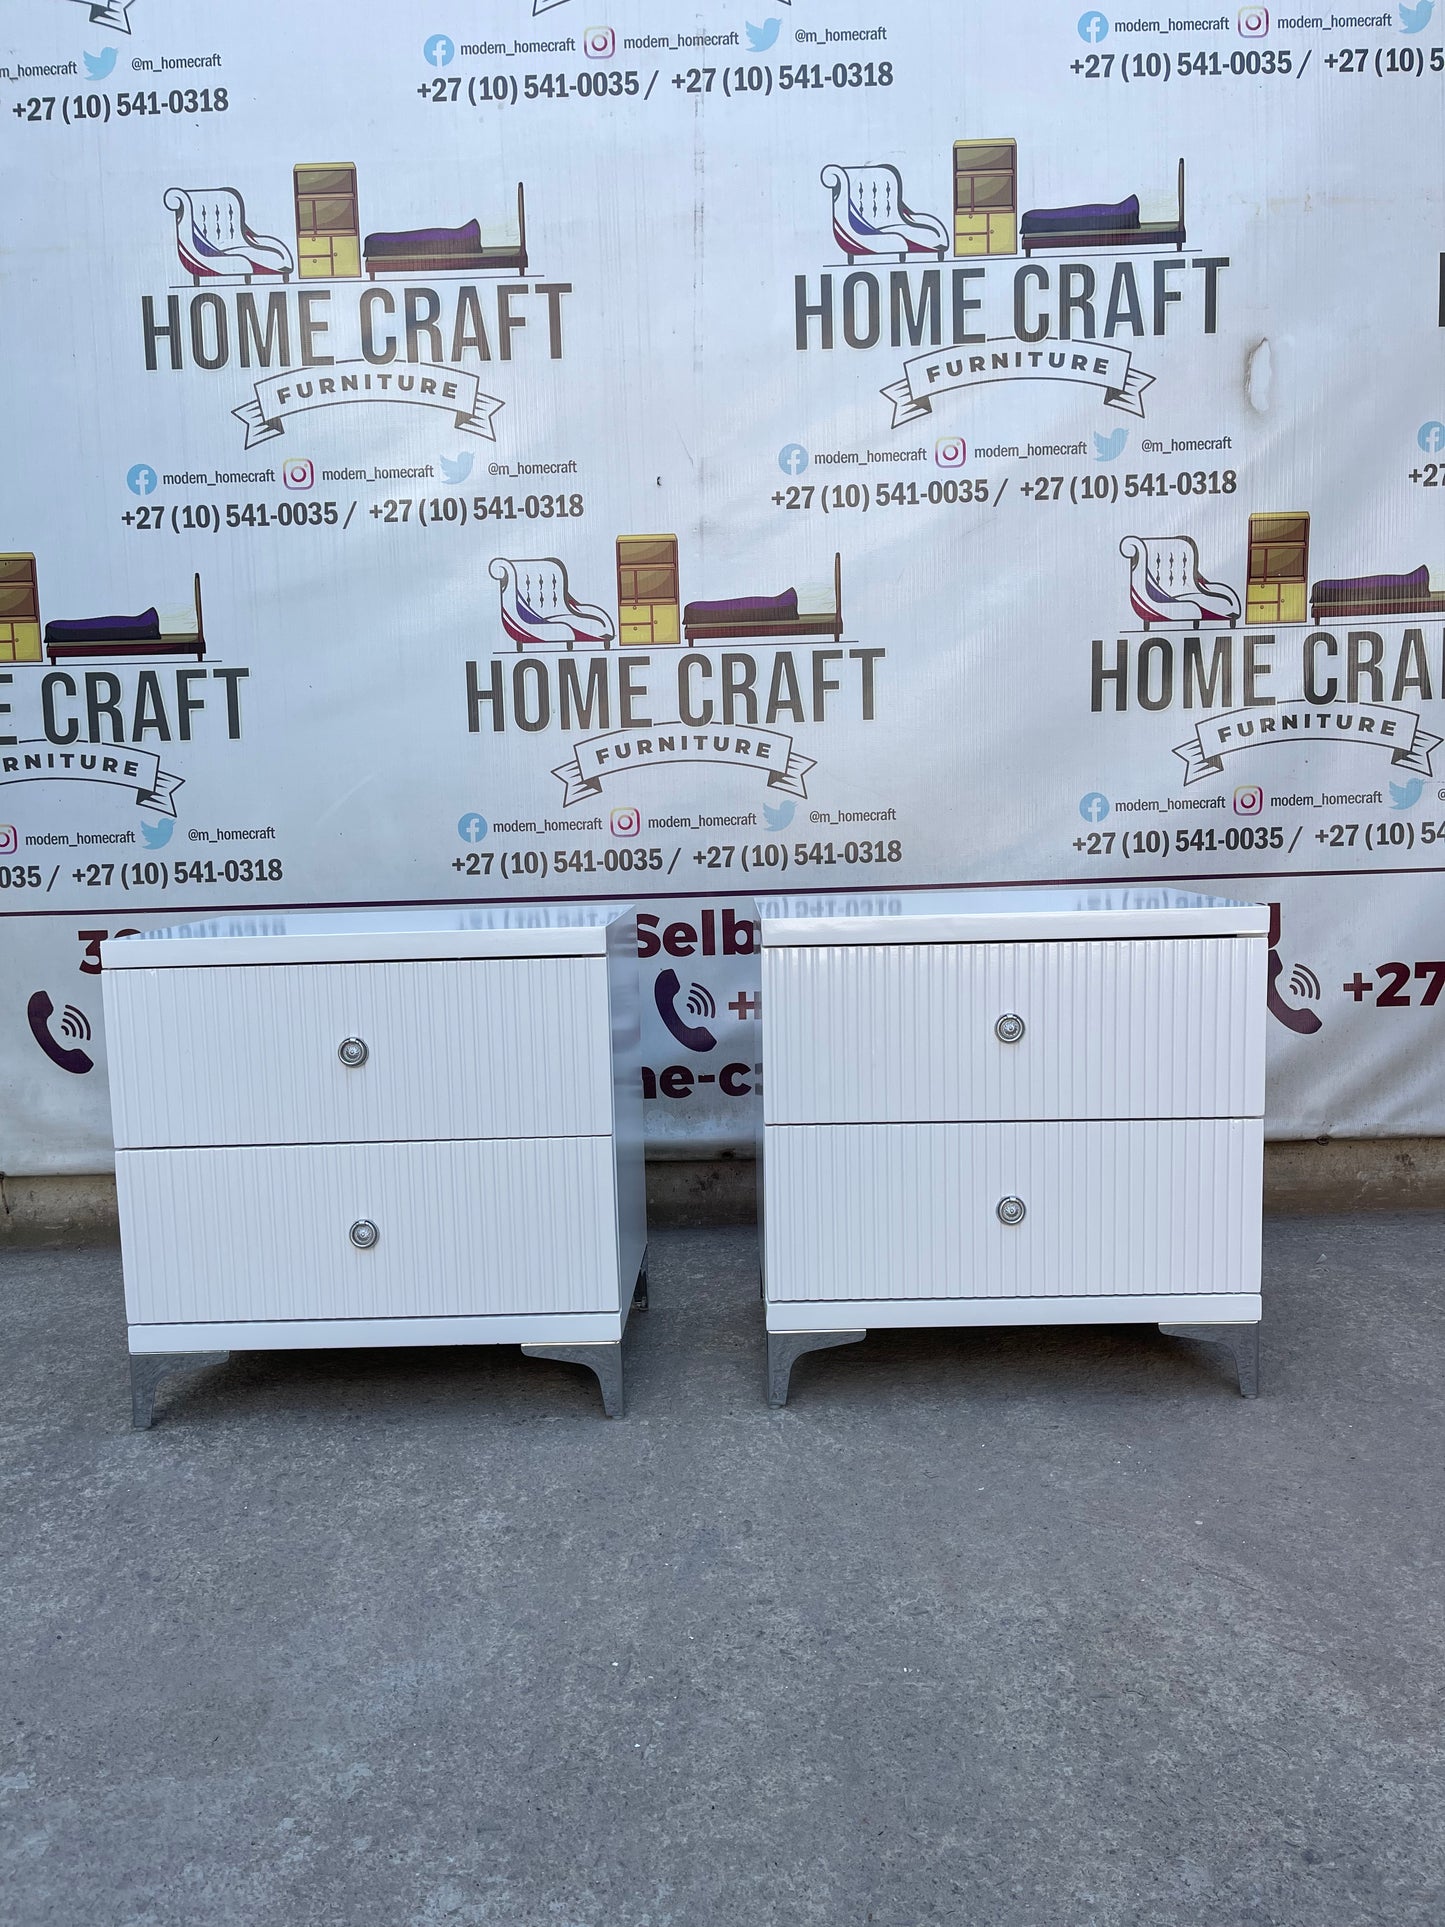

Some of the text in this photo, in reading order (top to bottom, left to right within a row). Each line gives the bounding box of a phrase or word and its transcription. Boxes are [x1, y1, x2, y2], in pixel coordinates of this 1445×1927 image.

[795, 26, 887, 44] @m_homecraft
[132, 53, 221, 72] @m_homecraft
[1070, 54, 1115, 78] +27
[1122, 53, 1170, 83] (10)
[1177, 50, 1292, 76] 541-0035
[1296, 49, 1312, 79] /
[1324, 49, 1368, 72] +27
[1375, 48, 1423, 77] (10)
[417, 62, 893, 106] +27 (10) 541-0035 / +27 (10) 541-0318
[13, 88, 228, 125] +27 (10) 541-0318
[795, 257, 1229, 350] HOME CRAFT
[141, 283, 572, 370] HOME CRAFT
[926, 351, 1109, 383] FURNITURE
[277, 374, 457, 404] FURNITURE
[1142, 436, 1232, 454] @m_homecraft
[488, 460, 577, 477] @m_homecraft
[772, 470, 1237, 513] +27 (10) 541-0035 / +27 (10) 541-0318
[122, 494, 584, 534] +27 (10) 541-0035 / +27 (10) 541-0318
[1091, 629, 1445, 712] HOME CRA
[41, 667, 249, 745] CRAFT
[466, 648, 885, 732] HOME CRAFT
[1218, 714, 1397, 742] FURNITURE
[596, 736, 772, 764] FURNITURE
[810, 808, 896, 825] @m_homecraft
[188, 827, 275, 843] @m_homecraft
[1073, 832, 1116, 854] +27
[1122, 831, 1169, 858] (10)
[1175, 827, 1283, 852] 541-0035
[1288, 826, 1303, 853] /
[1315, 824, 1359, 846] +27
[1365, 822, 1414, 850] (10)
[47, 865, 60, 892] /
[72, 864, 114, 886] +27
[121, 862, 168, 890] (10)
[174, 859, 282, 883] 541-0318
[452, 840, 902, 879] +27 (10) 541-0035 / +27 (10) 541-0318
